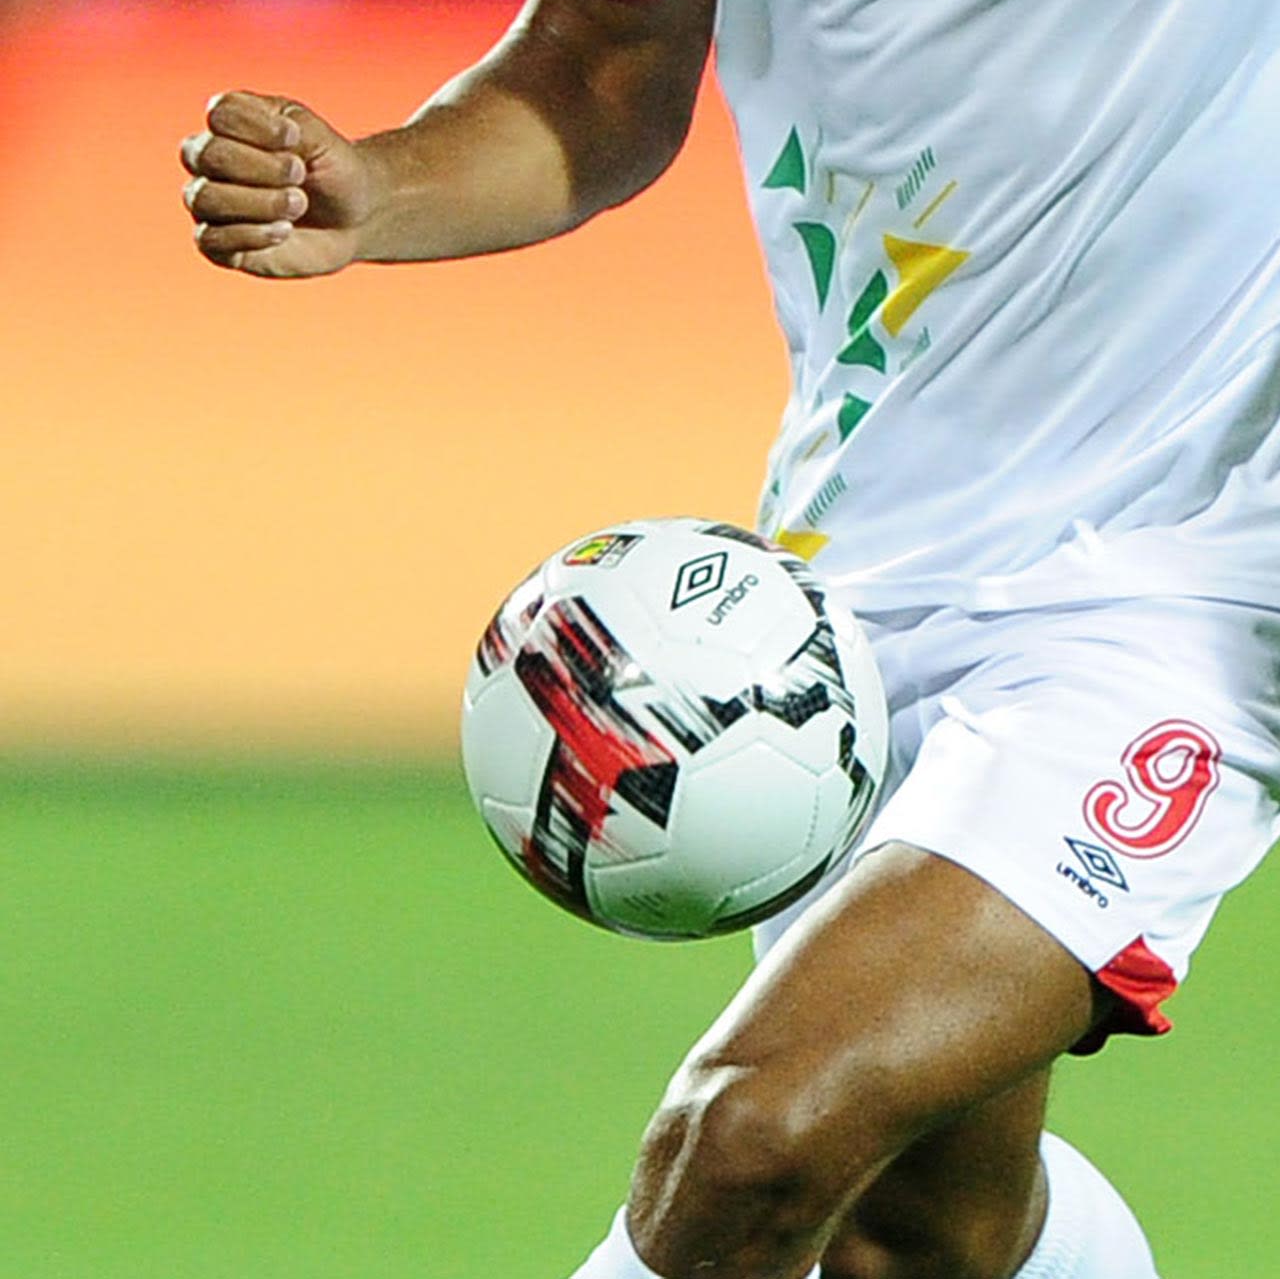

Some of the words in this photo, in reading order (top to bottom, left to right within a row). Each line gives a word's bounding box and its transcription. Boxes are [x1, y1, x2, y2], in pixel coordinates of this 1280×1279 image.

[705, 574, 759, 626] umbro
[1082, 719, 1223, 859] 9
[1056, 861, 1108, 909] umbro
